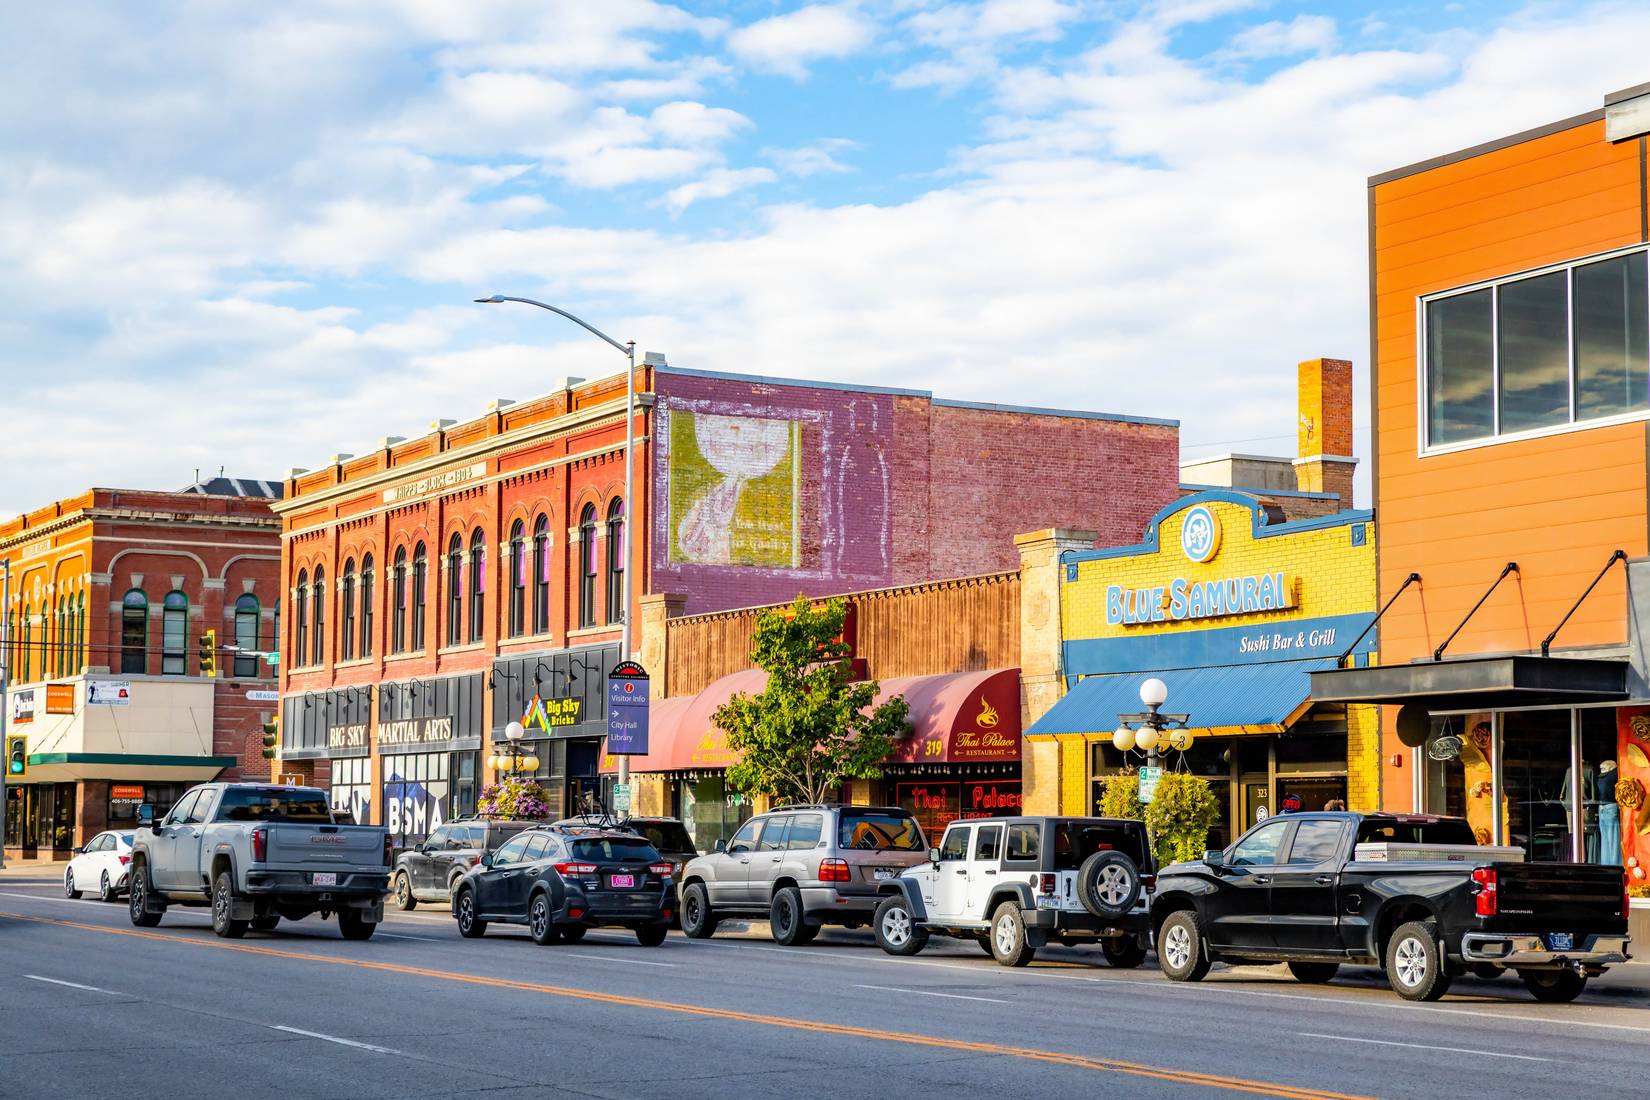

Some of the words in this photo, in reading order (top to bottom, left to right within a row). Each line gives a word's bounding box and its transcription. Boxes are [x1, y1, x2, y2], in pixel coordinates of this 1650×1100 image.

[1106, 585, 1165, 625] BLUE
[1169, 572, 1286, 620] SAMURAI
[1240, 631, 1270, 653] Sushi
[1272, 633, 1292, 651] Bar
[1295, 634, 1305, 648] &
[1308, 628, 1336, 648] Grill
[611, 694, 631, 702] Visitor
[633, 694, 646, 703] Info
[546, 700, 562, 716] Big
[563, 698, 580, 715] Sky
[551, 715, 575, 726] Bricks
[611, 721, 624, 730] City
[624, 721, 638, 729] Hall
[330, 727, 345, 747] BIG
[347, 725, 367, 746] SKY
[377, 721, 420, 744] MARTIAL
[423, 718, 451, 741] ARTS
[611, 733, 633, 743] Library
[955, 732, 980, 748] Thai
[982, 732, 1015, 747] Palace
[924, 740, 943, 757] 319
[1141, 769, 1146, 779] 2
[911, 786, 947, 809] Thai
[1257, 788, 1268, 798] 323
[389, 797, 444, 834] BSMA
